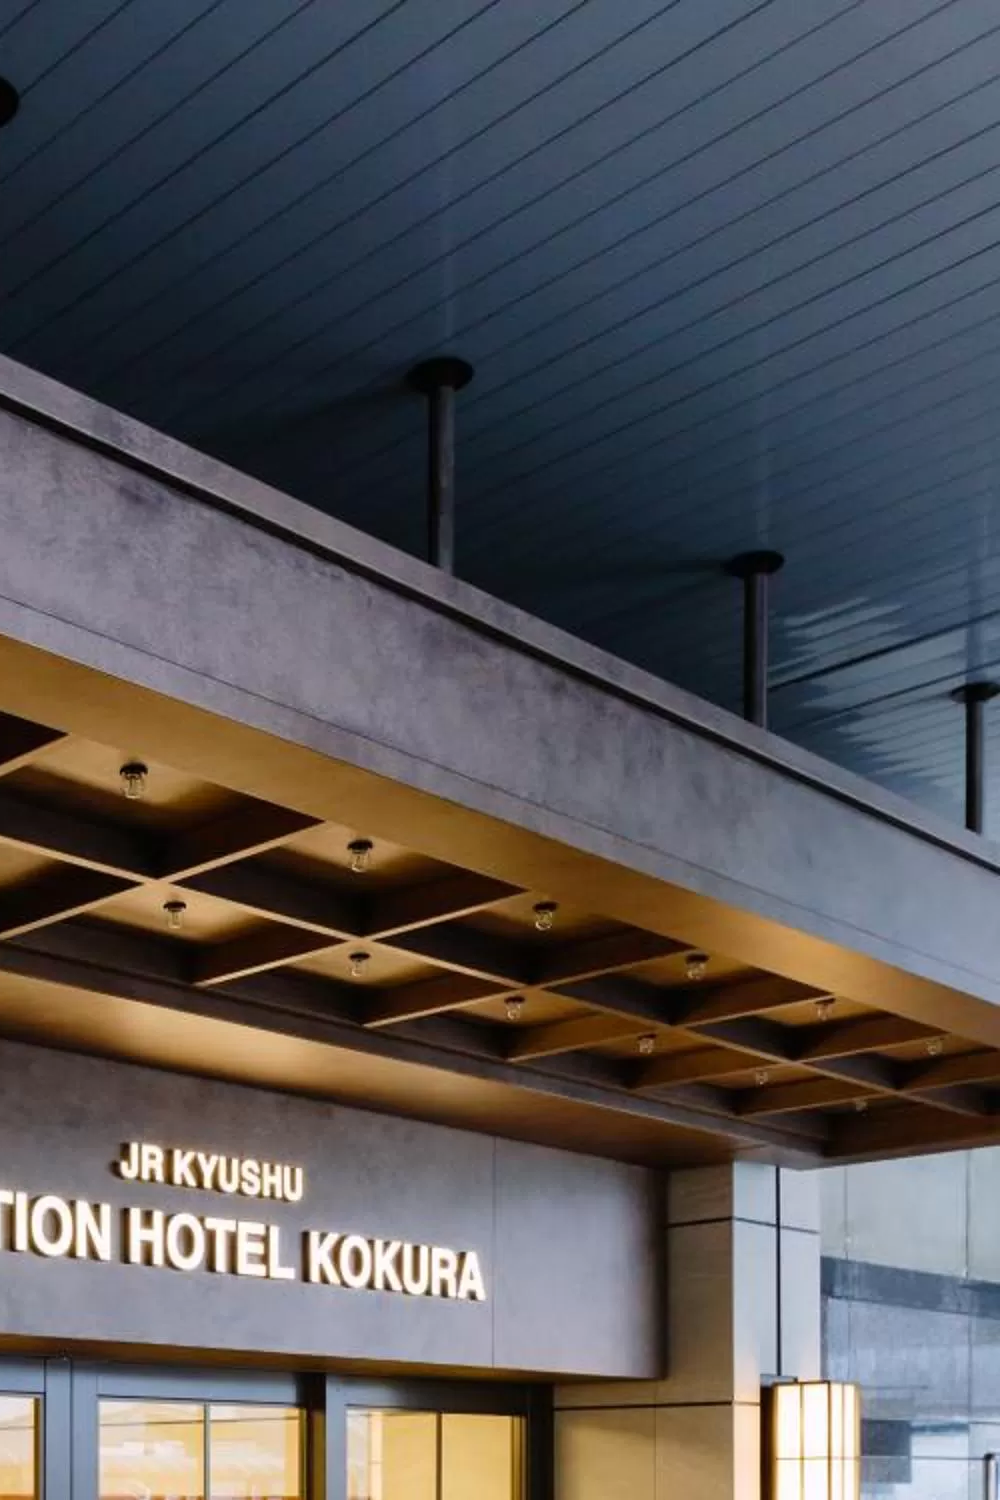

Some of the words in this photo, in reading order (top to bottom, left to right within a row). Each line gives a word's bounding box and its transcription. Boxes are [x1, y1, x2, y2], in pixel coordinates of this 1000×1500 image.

[119, 1142, 164, 1182] JR
[172, 1149, 304, 1202] KYUSHU
[127, 1207, 295, 1280] HOTEL
[308, 1231, 485, 1301] KOKURA
